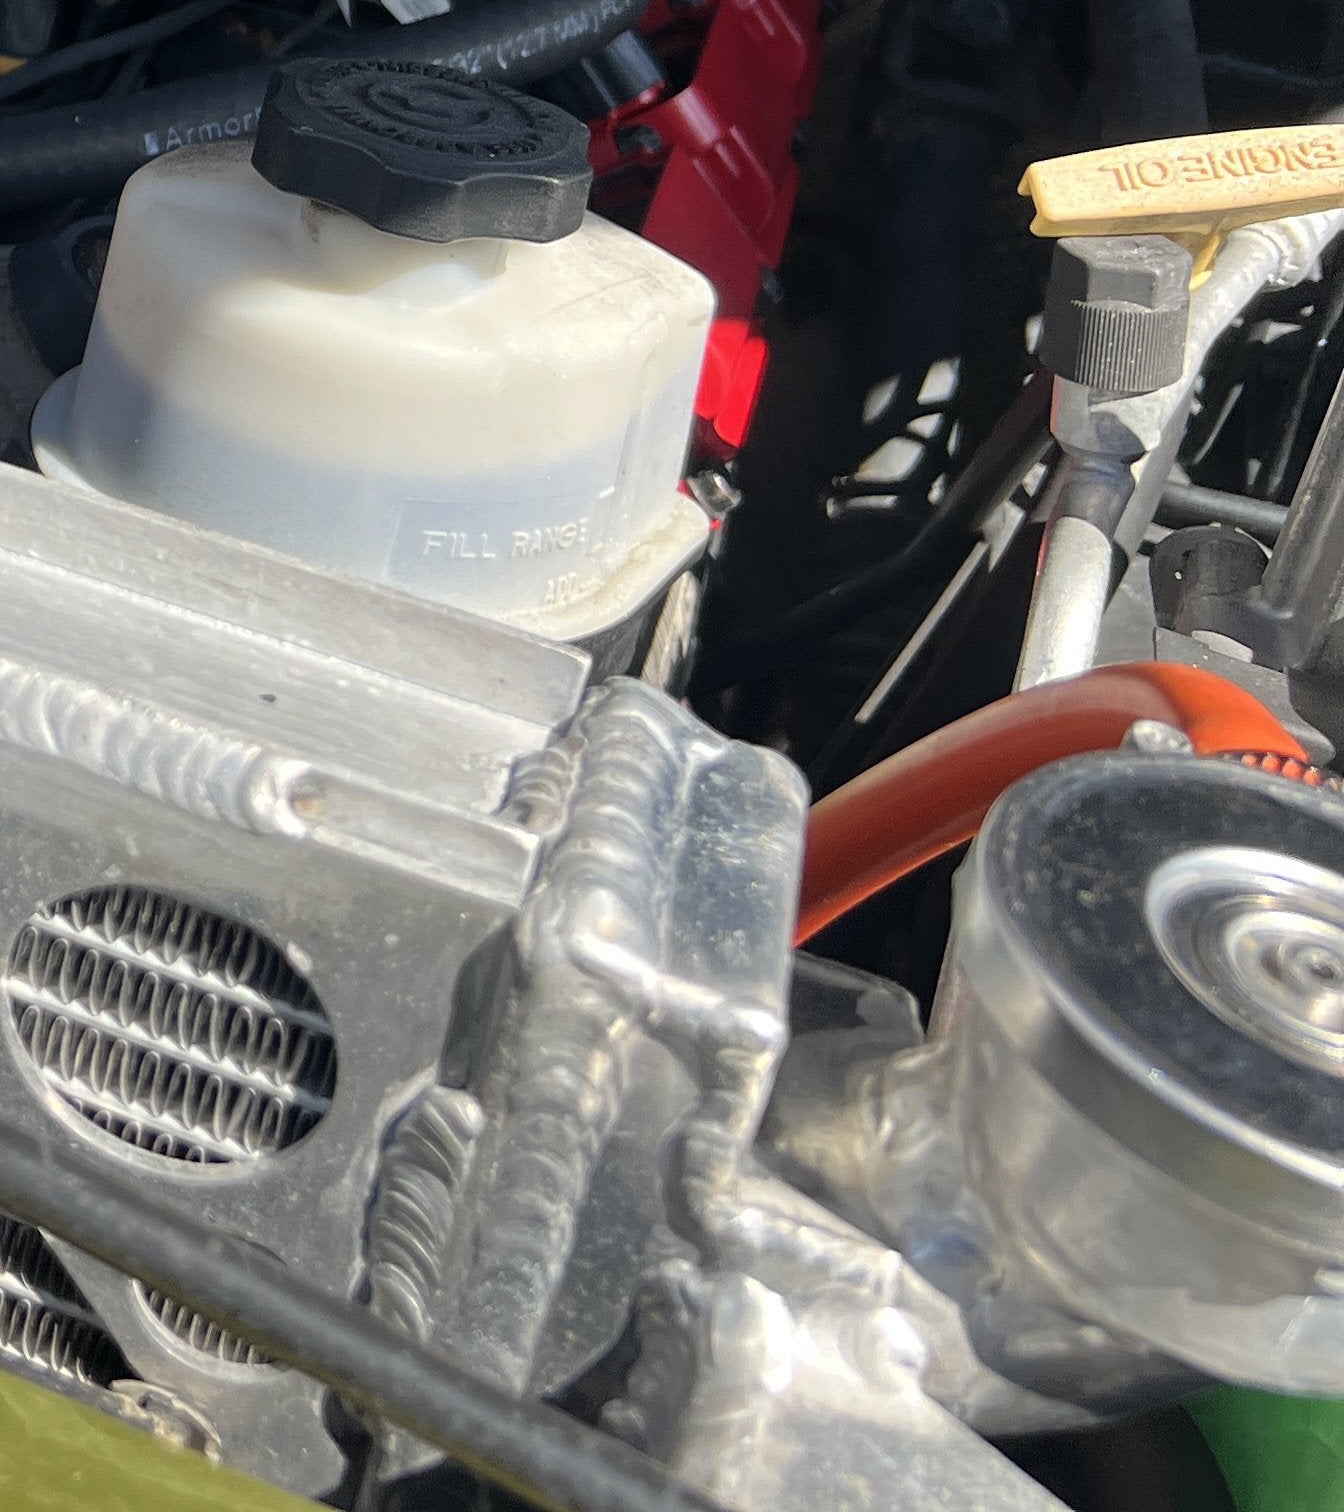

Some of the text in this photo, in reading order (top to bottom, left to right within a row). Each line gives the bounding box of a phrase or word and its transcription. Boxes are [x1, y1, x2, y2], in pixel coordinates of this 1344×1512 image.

[166, 104, 262, 151] Armor
[1098, 138, 1344, 192] ENGINE OIL
[422, 516, 590, 559] FILL RANGE
